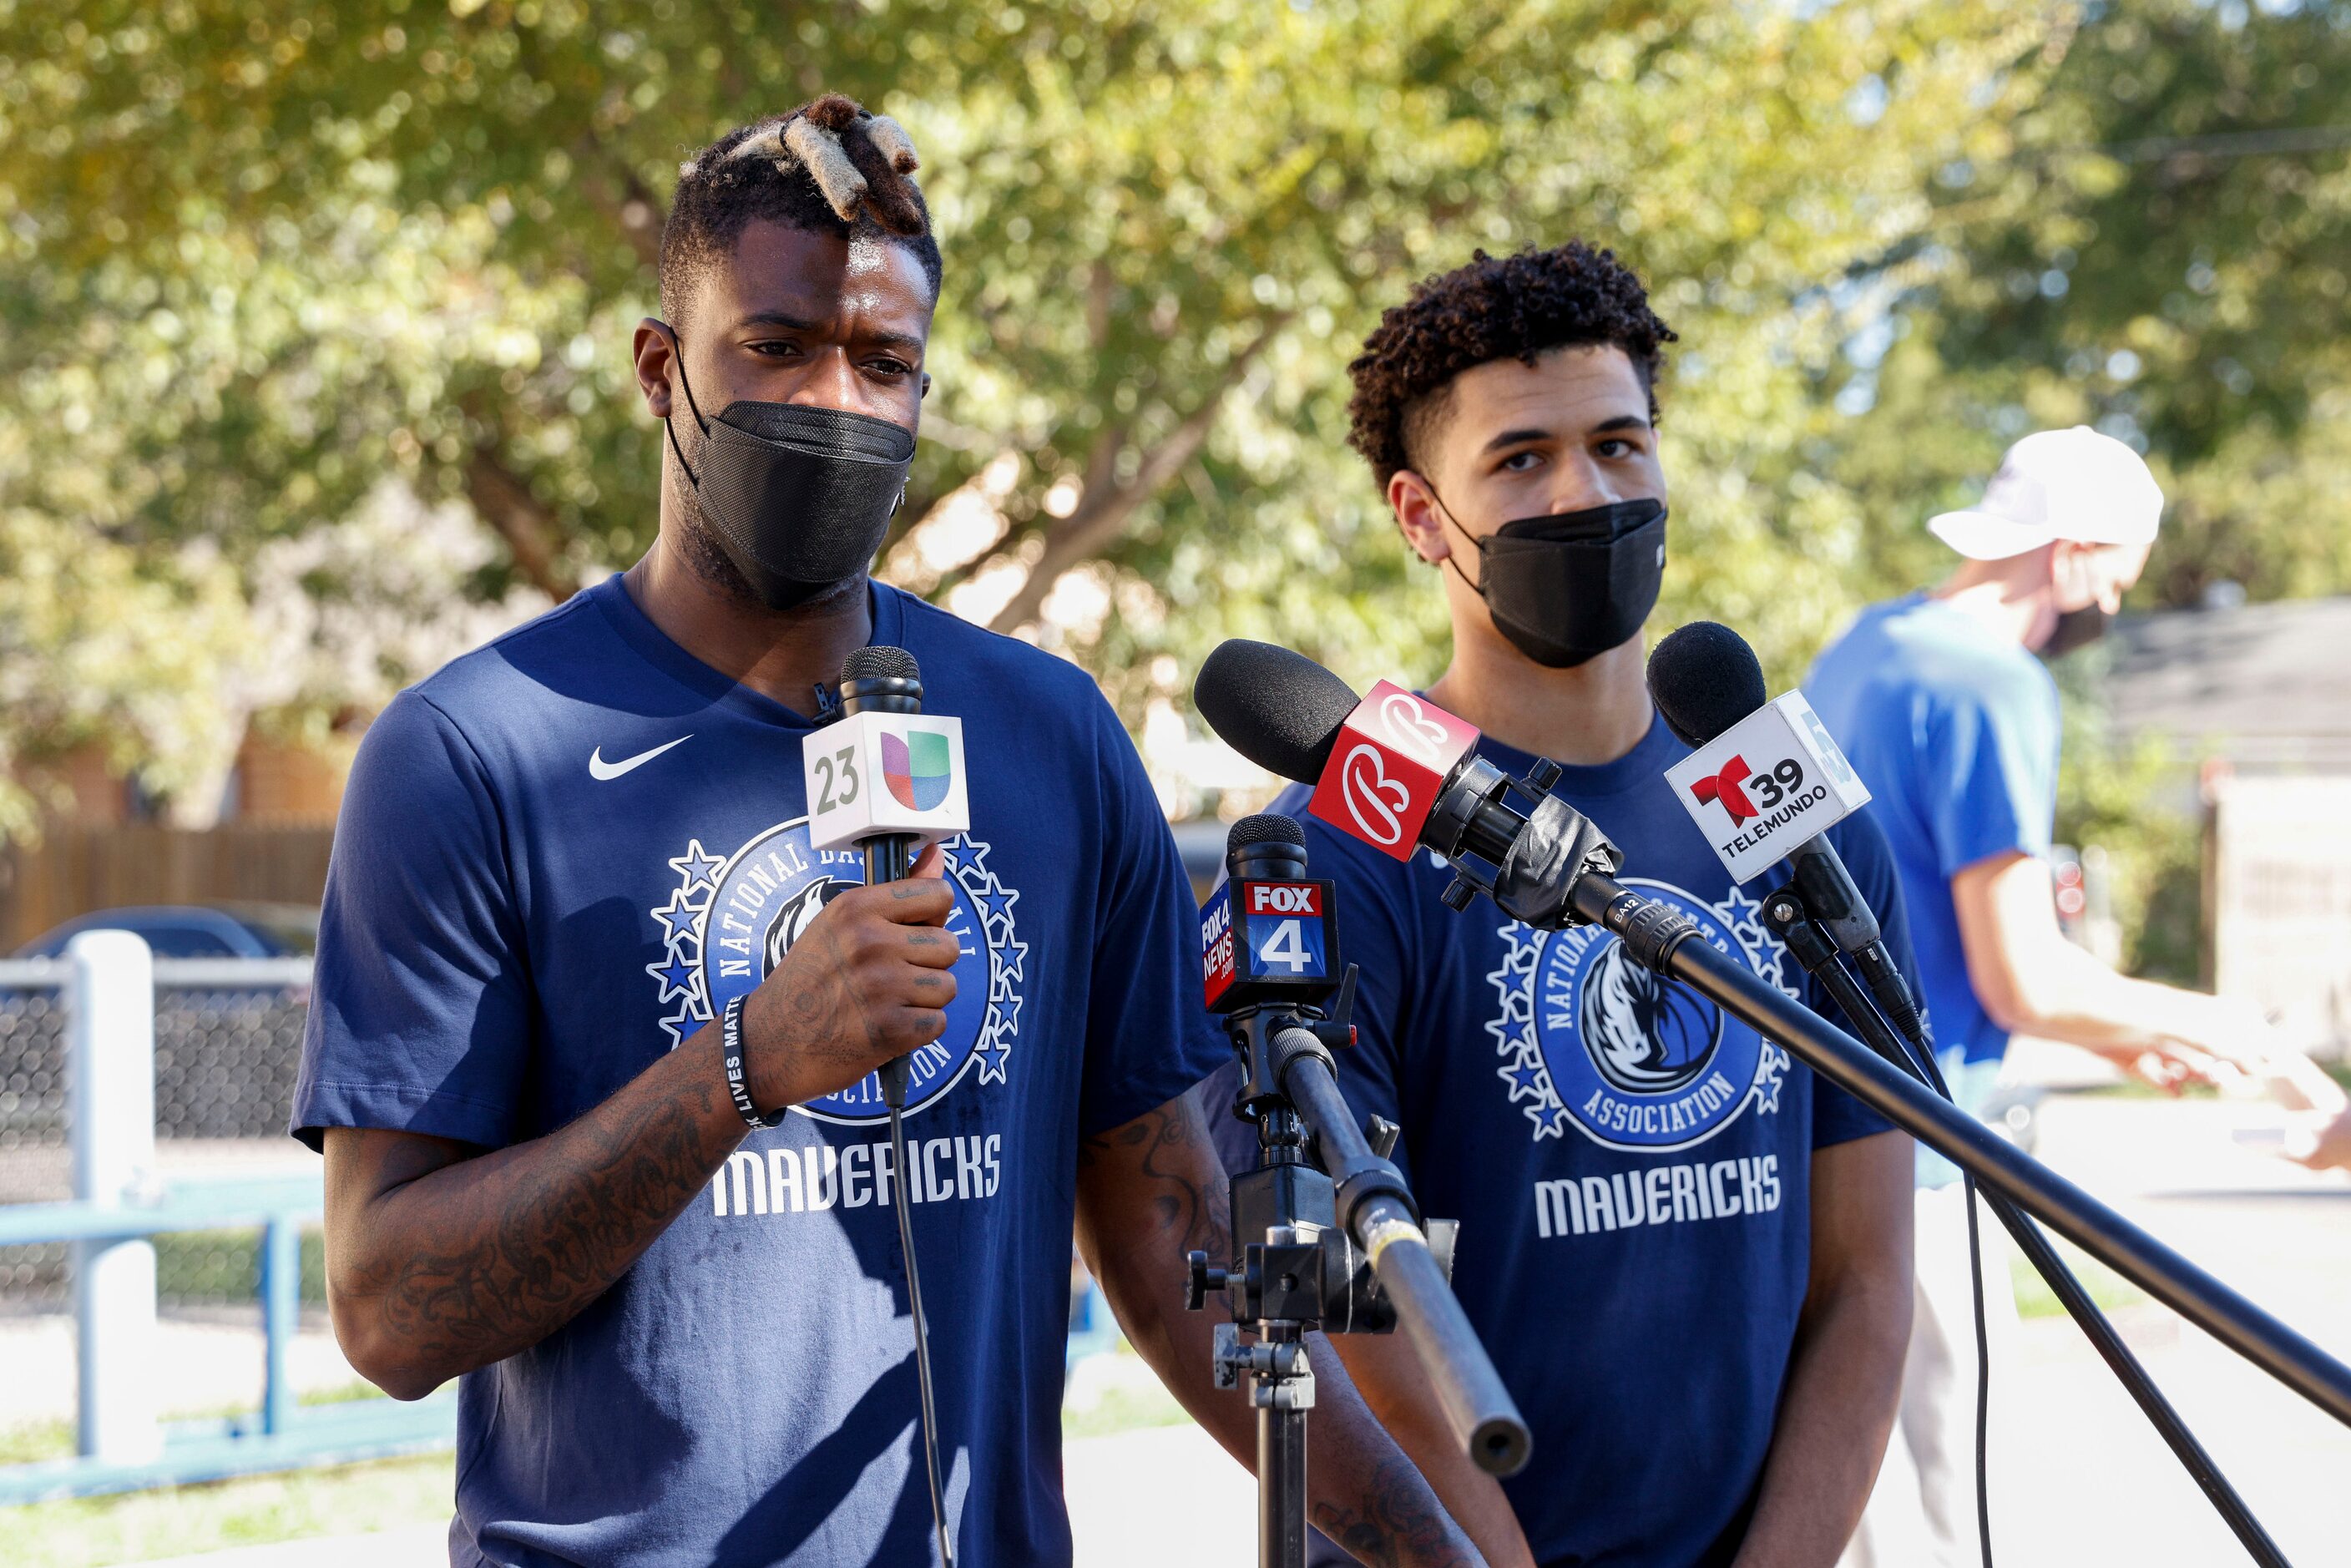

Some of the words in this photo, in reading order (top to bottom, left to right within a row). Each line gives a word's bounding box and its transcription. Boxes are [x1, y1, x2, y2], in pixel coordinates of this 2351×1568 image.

[814, 745, 859, 816] 23
[1342, 743, 1410, 845] B
[1749, 758, 1804, 809] 39
[1722, 785, 1827, 858] TELEMUNDO
[719, 842, 810, 978] NATIONAL
[1201, 906, 1223, 952] FOX
[1221, 898, 1231, 927] 4
[1253, 886, 1315, 913] FOX
[1614, 898, 1640, 924] BA12
[1203, 931, 1233, 981] NEWS
[1221, 956, 1234, 980] .com
[1260, 919, 1312, 972] 4
[726, 1055, 753, 1111] LIVES
[1583, 1070, 1737, 1135] ASSOCIATION
[1534, 1154, 1782, 1238] MAVERICKS
